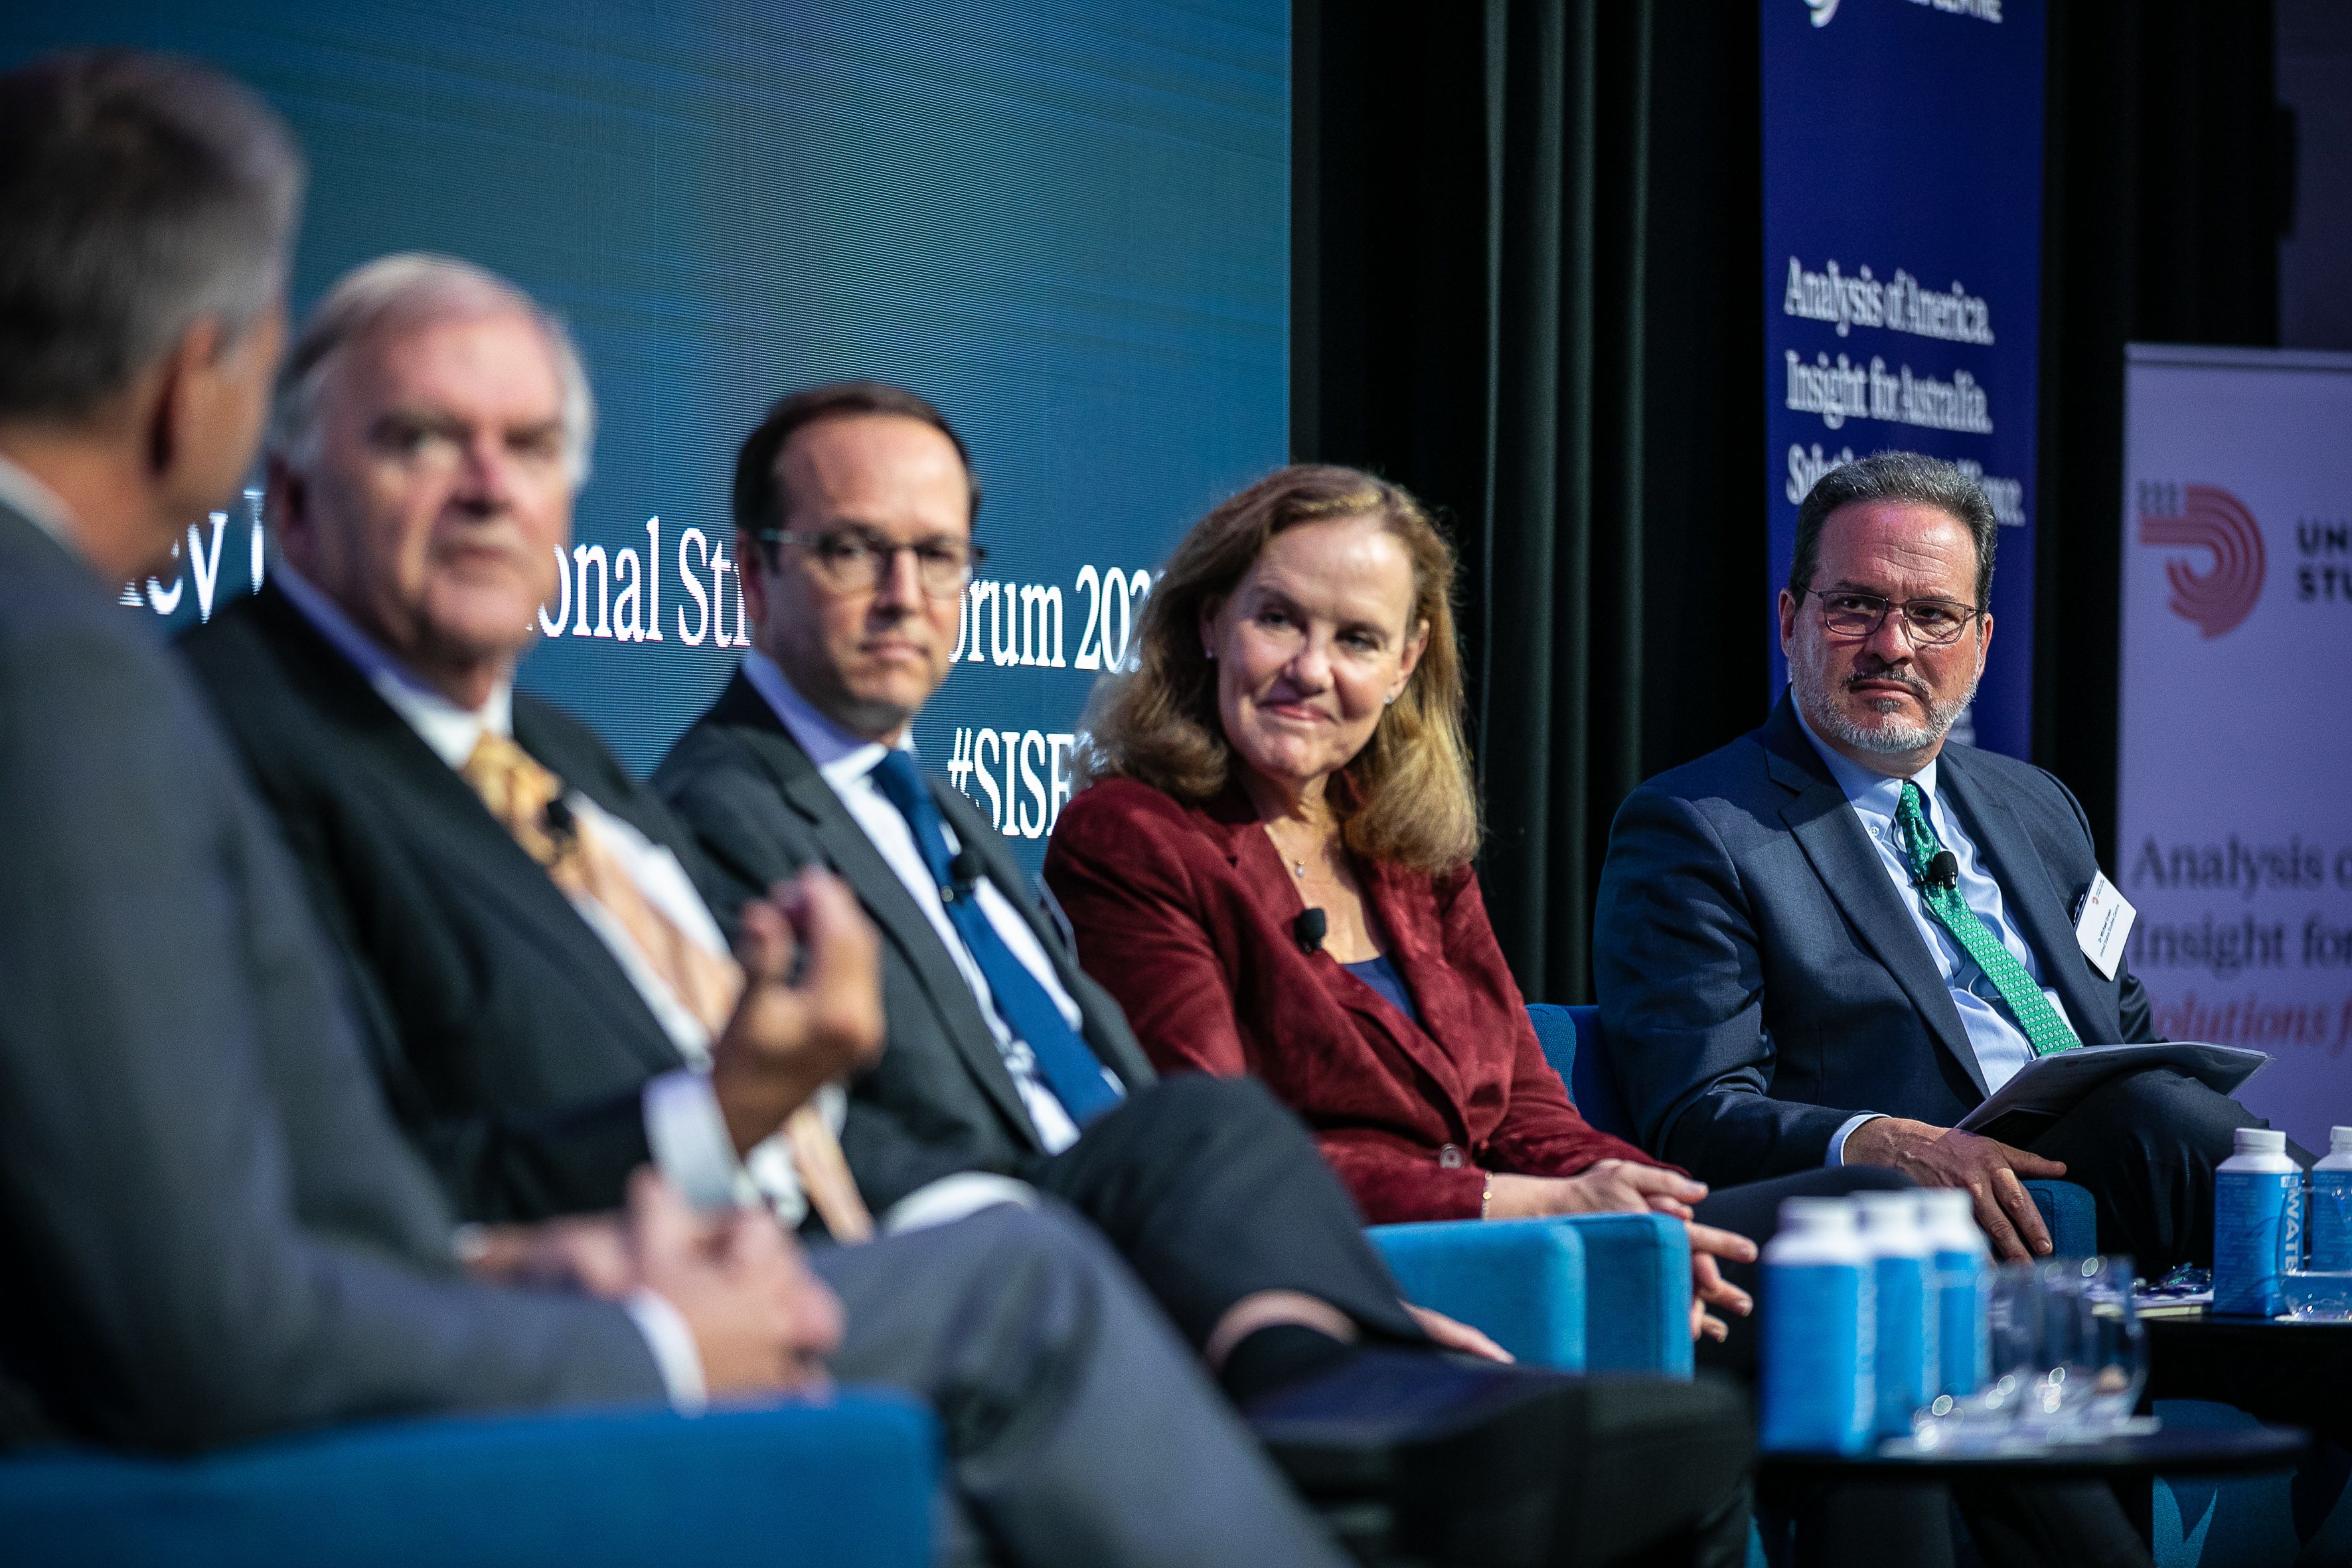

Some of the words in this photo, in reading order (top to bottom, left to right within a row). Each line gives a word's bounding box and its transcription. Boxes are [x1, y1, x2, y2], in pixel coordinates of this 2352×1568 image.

[1784, 256, 1884, 337] Analysis
[1884, 268, 1908, 332] of
[1784, 349, 1868, 430] Insight
[1869, 354, 1900, 421] for
[531, 515, 663, 642] onal
[2131, 833, 2323, 902] Analysis
[2132, 909, 2284, 981] Insight
[2151, 992, 2325, 1046] olutions
